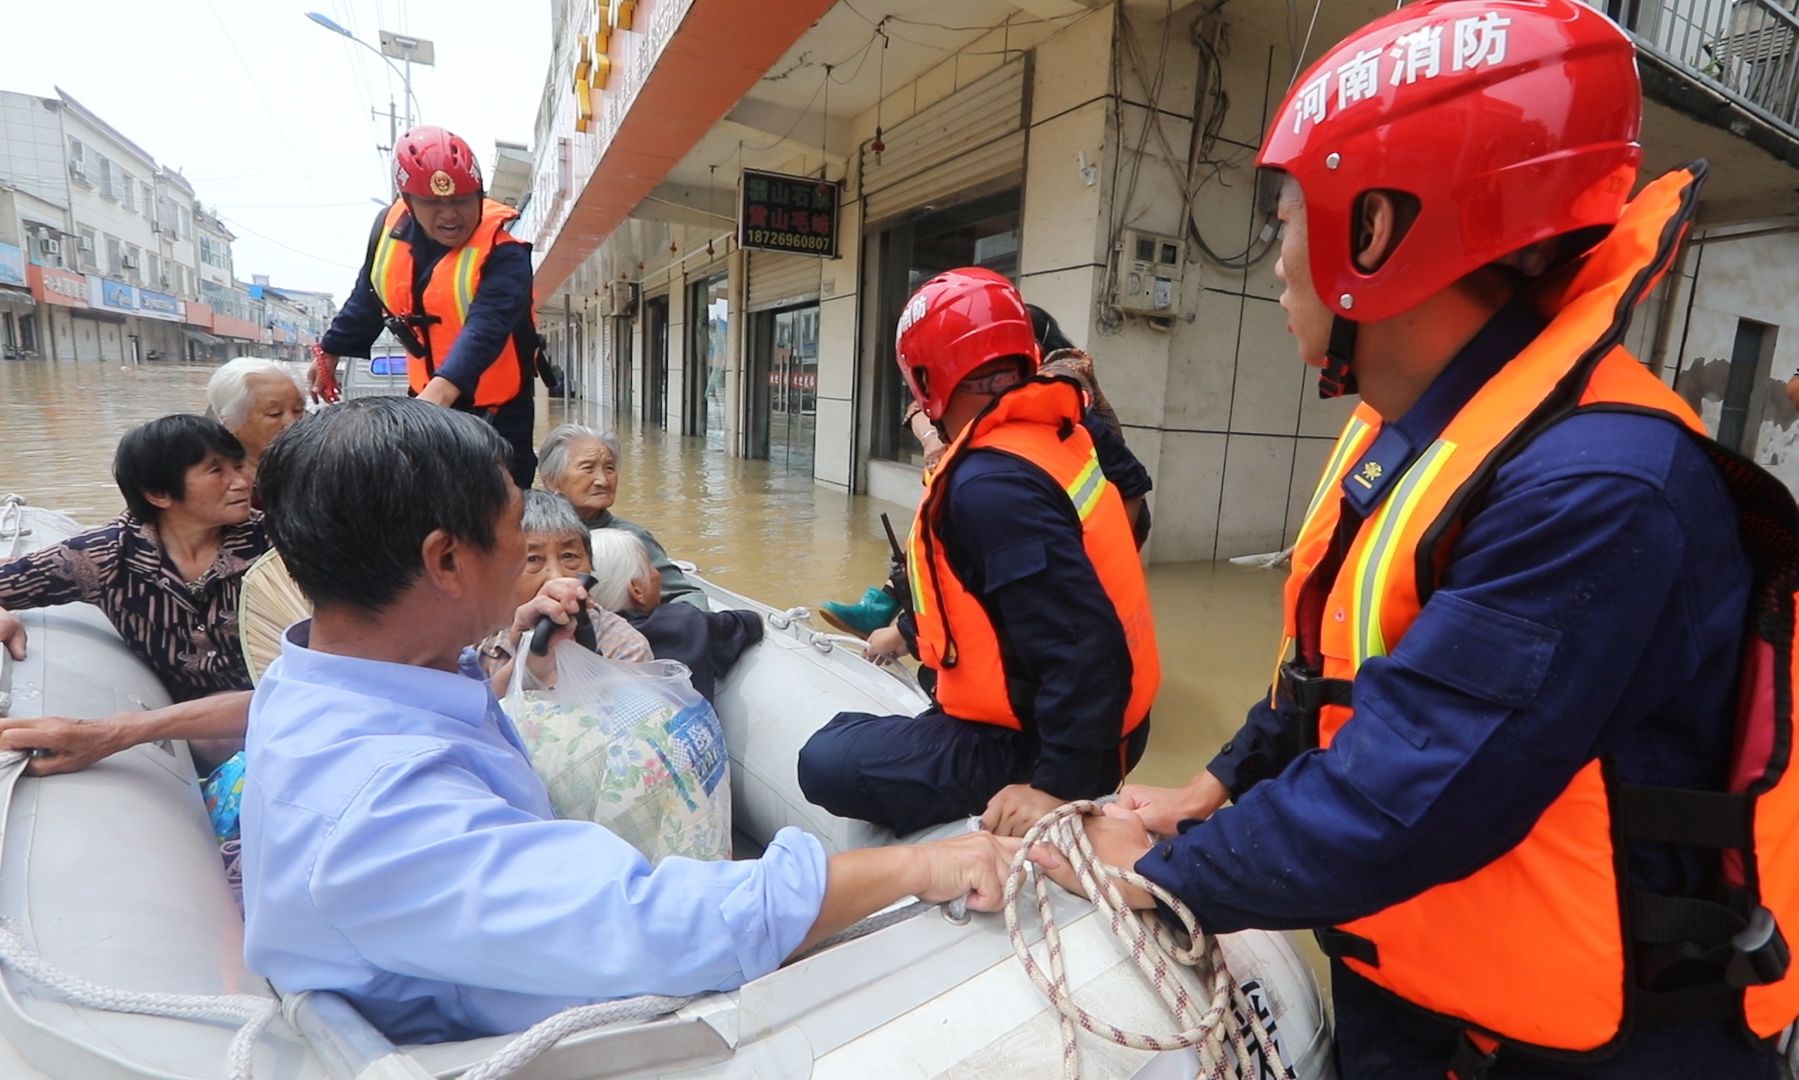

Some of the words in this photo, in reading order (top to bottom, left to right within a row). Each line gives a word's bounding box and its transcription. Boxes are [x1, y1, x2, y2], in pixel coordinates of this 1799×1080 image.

[1293, 11, 1511, 134] 河南消防
[747, 229, 829, 250] 18726960807
